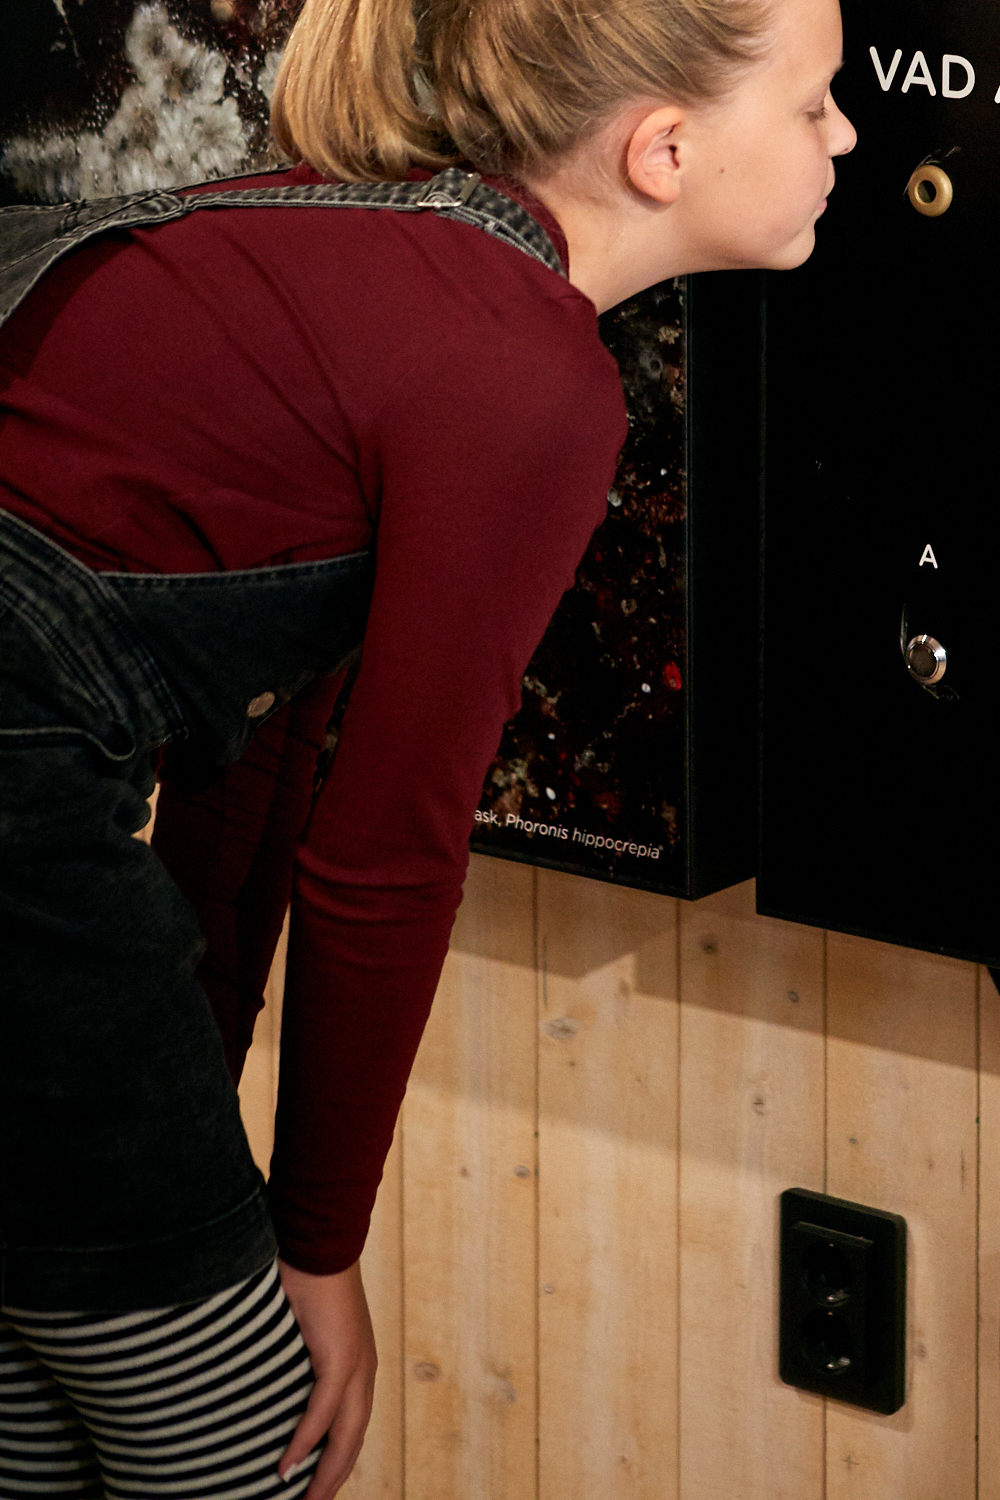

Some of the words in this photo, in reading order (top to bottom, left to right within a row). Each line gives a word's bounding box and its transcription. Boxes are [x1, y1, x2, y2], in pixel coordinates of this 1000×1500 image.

[868, 45, 976, 100] VAD
[918, 542, 940, 570] A
[473, 808, 503, 828] ask,
[504, 811, 570, 841] Phoronis
[571, 827, 661, 860] hippocrepia
